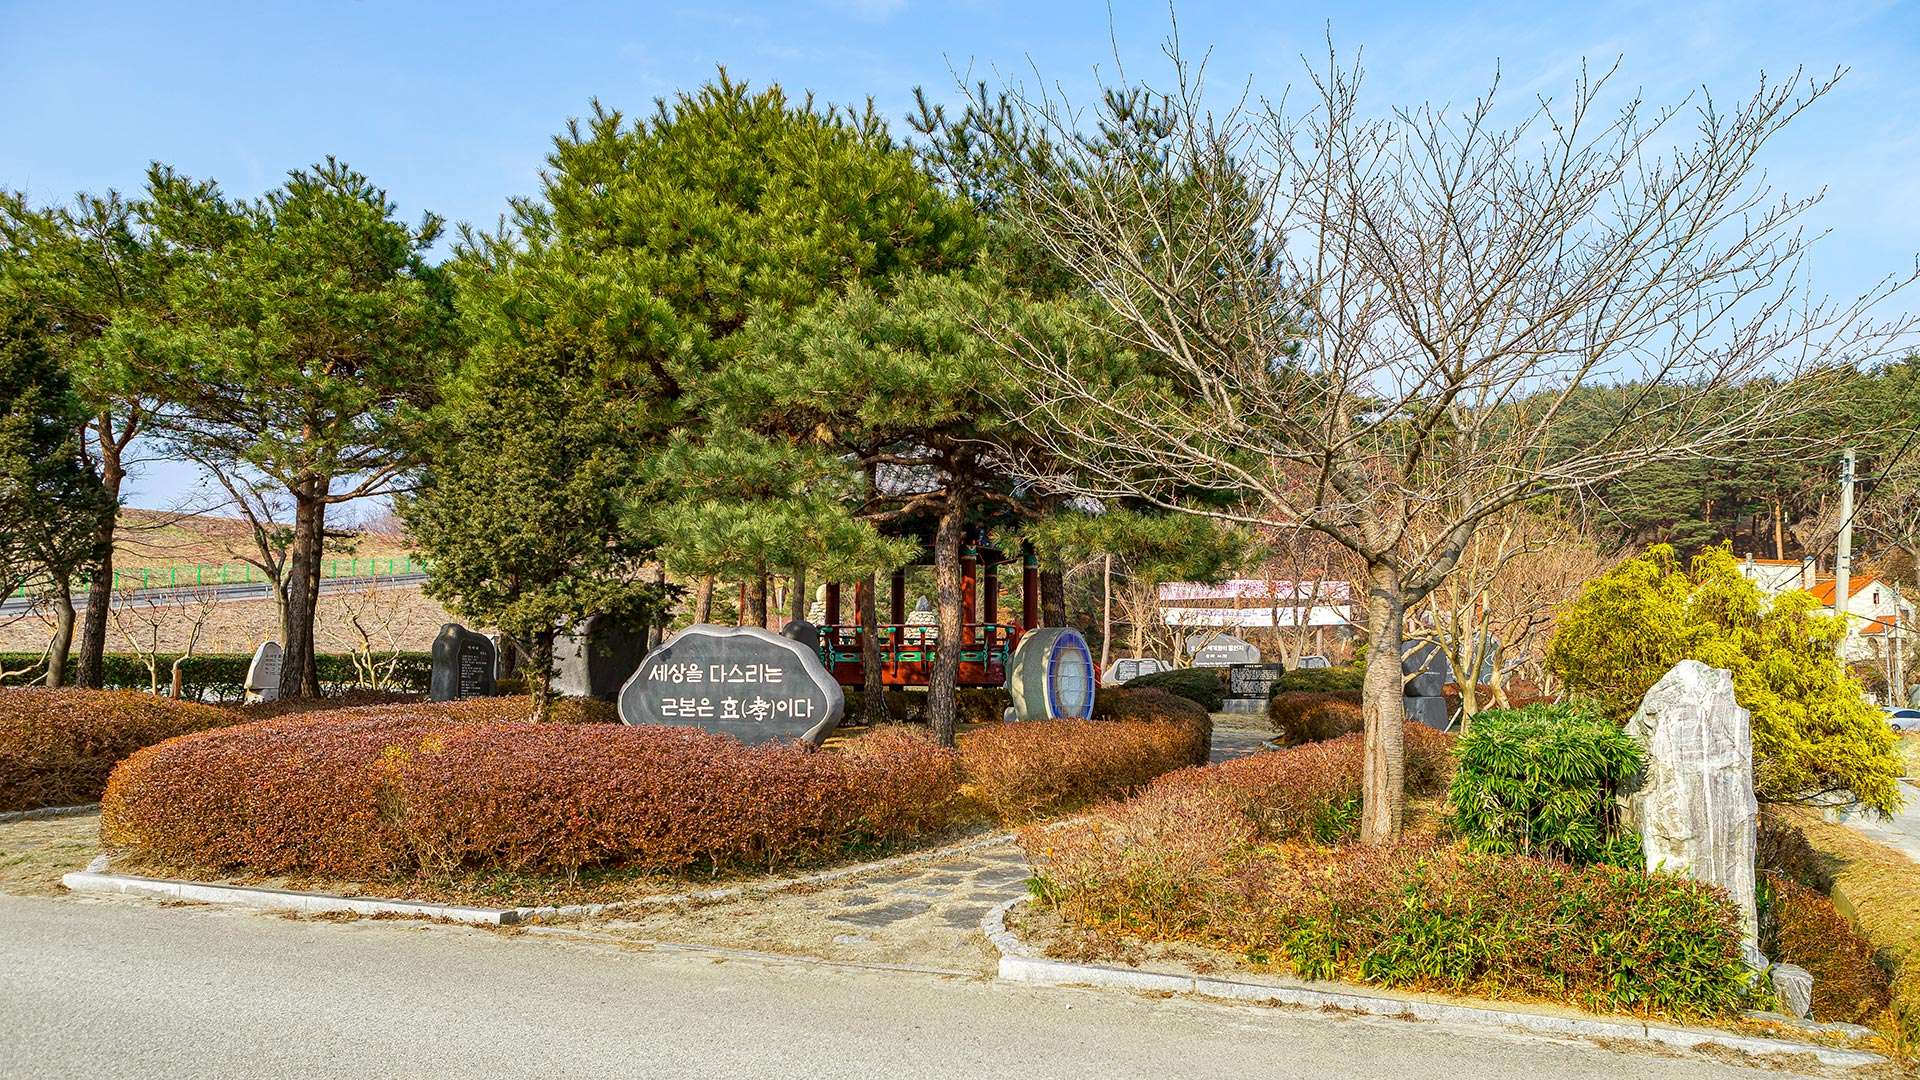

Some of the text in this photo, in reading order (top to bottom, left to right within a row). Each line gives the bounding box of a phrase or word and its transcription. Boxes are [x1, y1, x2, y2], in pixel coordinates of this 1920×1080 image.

[648, 663, 783, 683] 세상을 다스리는
[660, 696, 815, 721] 근본은 효(孝)이다
